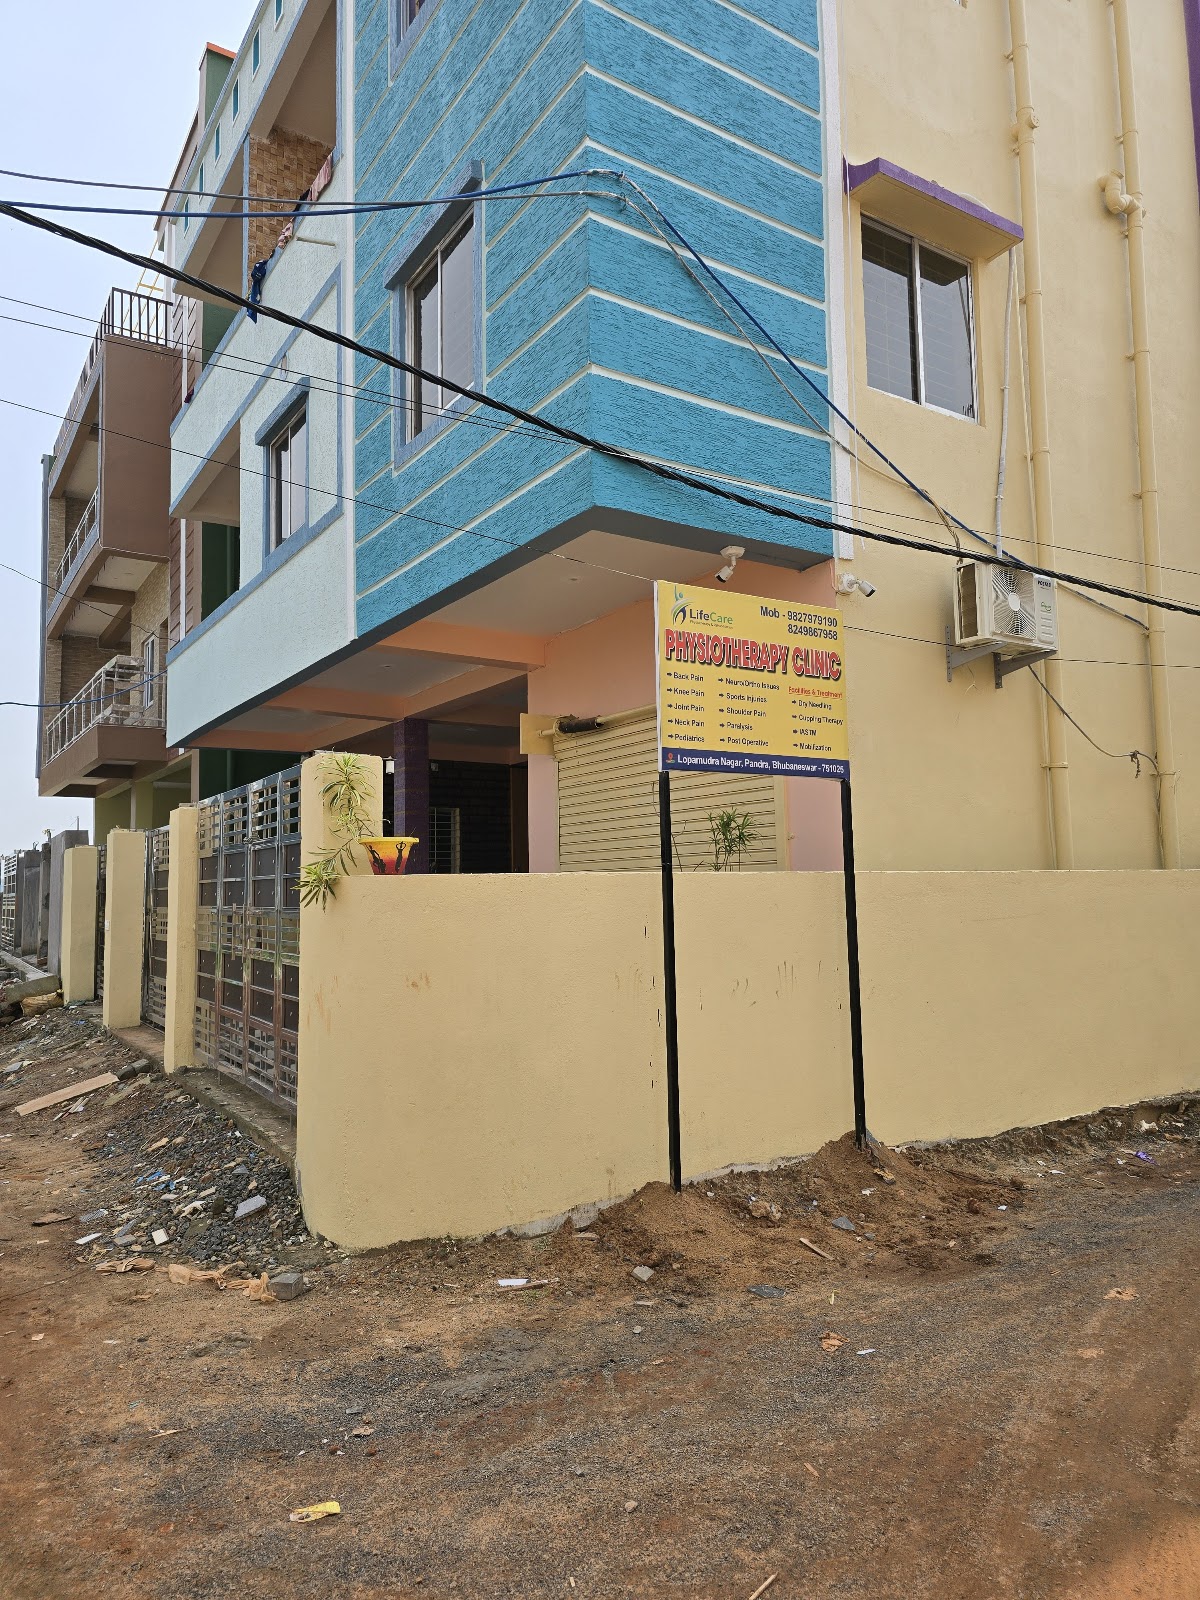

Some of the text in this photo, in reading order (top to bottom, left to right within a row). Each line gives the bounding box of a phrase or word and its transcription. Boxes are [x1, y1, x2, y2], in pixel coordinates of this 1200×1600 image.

[690, 609, 733, 624] LifeCare
[760, 606, 779, 618] Mob
[787, 611, 837, 627] 9827979190
[788, 624, 838, 640] 8249867958
[665, 629, 841, 681] PHYSIOTHERAPY CLINIC
[674, 672, 688, 680] Back
[762, 682, 780, 690] Issues
[674, 688, 690, 696] Knee
[746, 695, 767, 703] Injuries
[674, 703, 689, 711] Joint
[798, 700, 832, 710] Dry Needling
[726, 707, 752, 716] Shoulder
[798, 714, 844, 726] Cupping Therapy
[726, 722, 752, 731] Paralysis
[674, 734, 704, 742] Pediatrics
[742, 738, 768, 746] Operative
[800, 743, 832, 752] Mobilization
[678, 754, 720, 766] Lopamudra
[720, 757, 744, 768] Nagar,
[744, 759, 770, 770] Pandra,
[772, 761, 817, 772] Bhubaneswar
